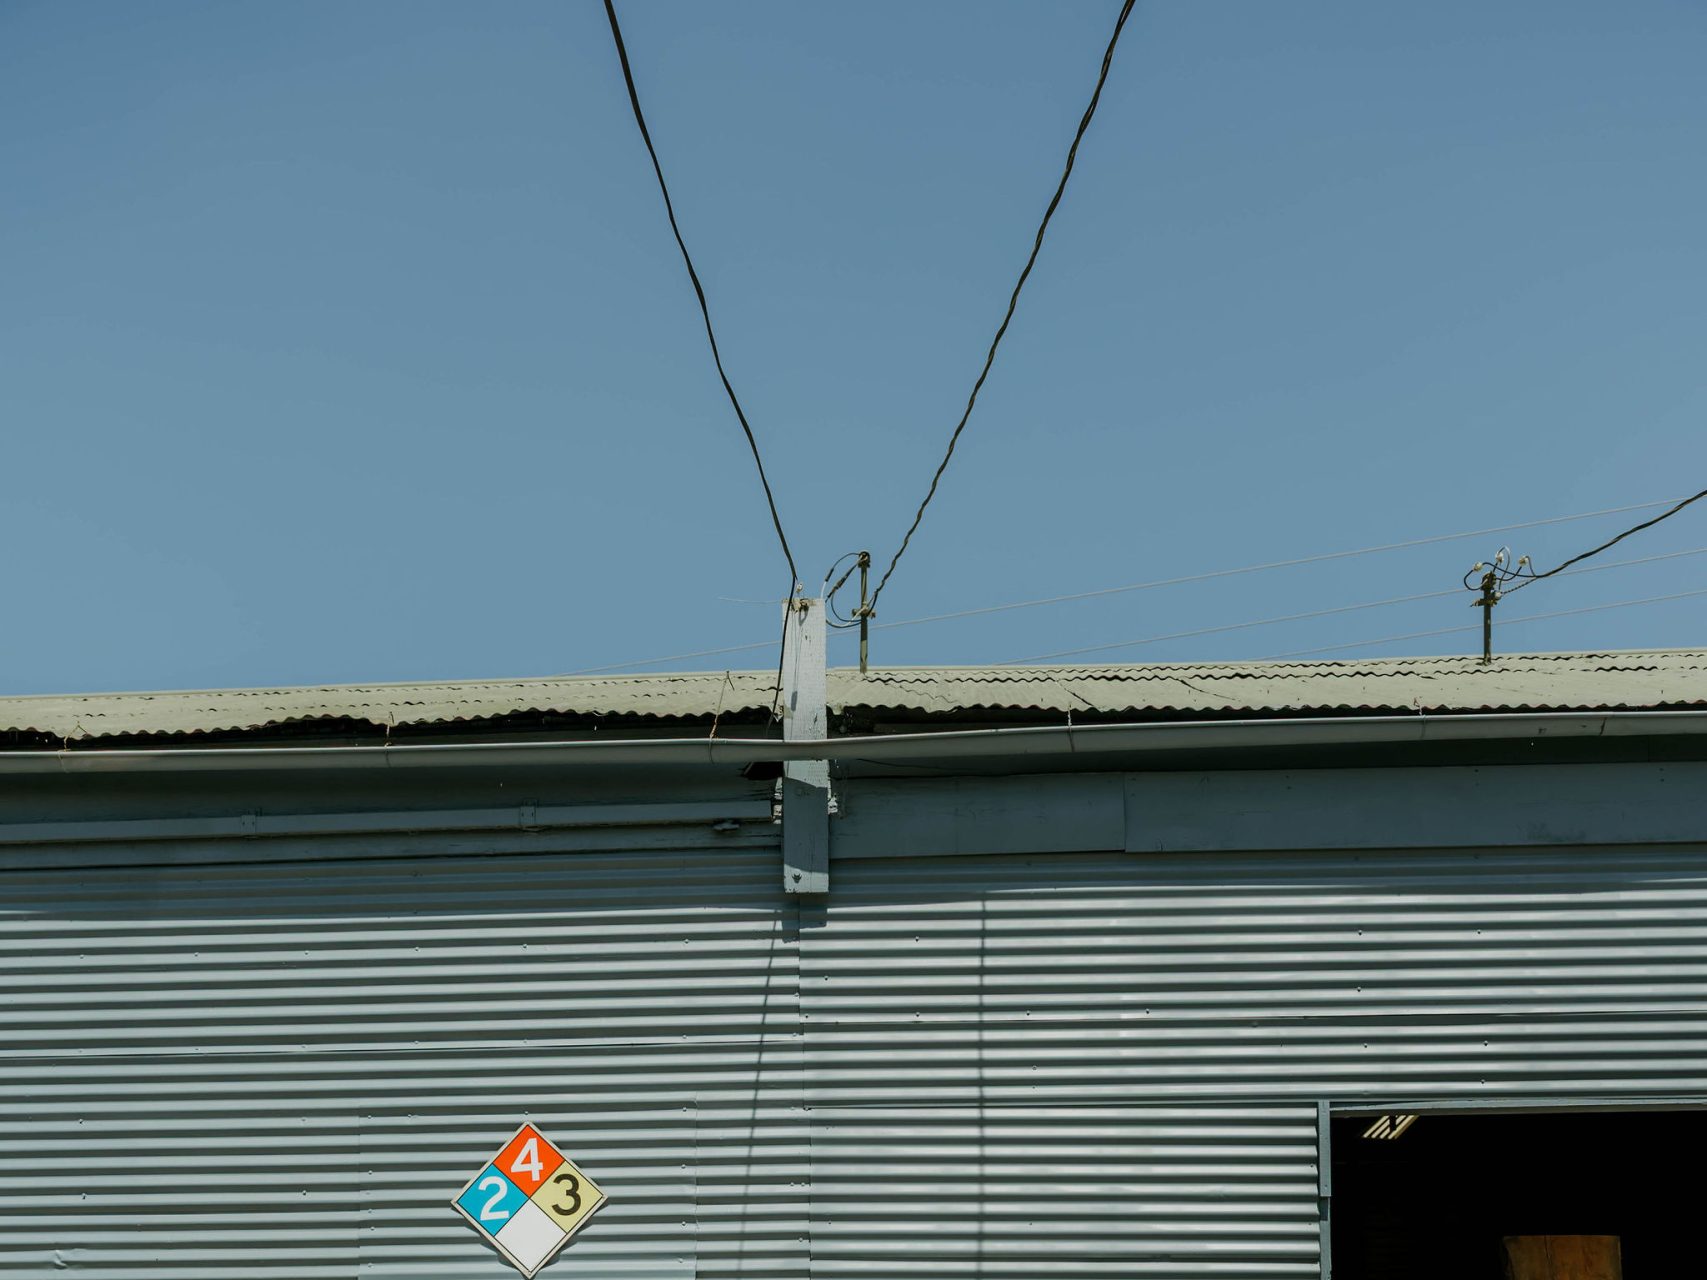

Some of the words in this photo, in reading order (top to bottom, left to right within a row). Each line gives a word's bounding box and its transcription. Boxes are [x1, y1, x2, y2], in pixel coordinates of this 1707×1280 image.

[510, 1137, 544, 1182] 4
[478, 1175, 510, 1221] 2
[551, 1173, 582, 1216] 3
